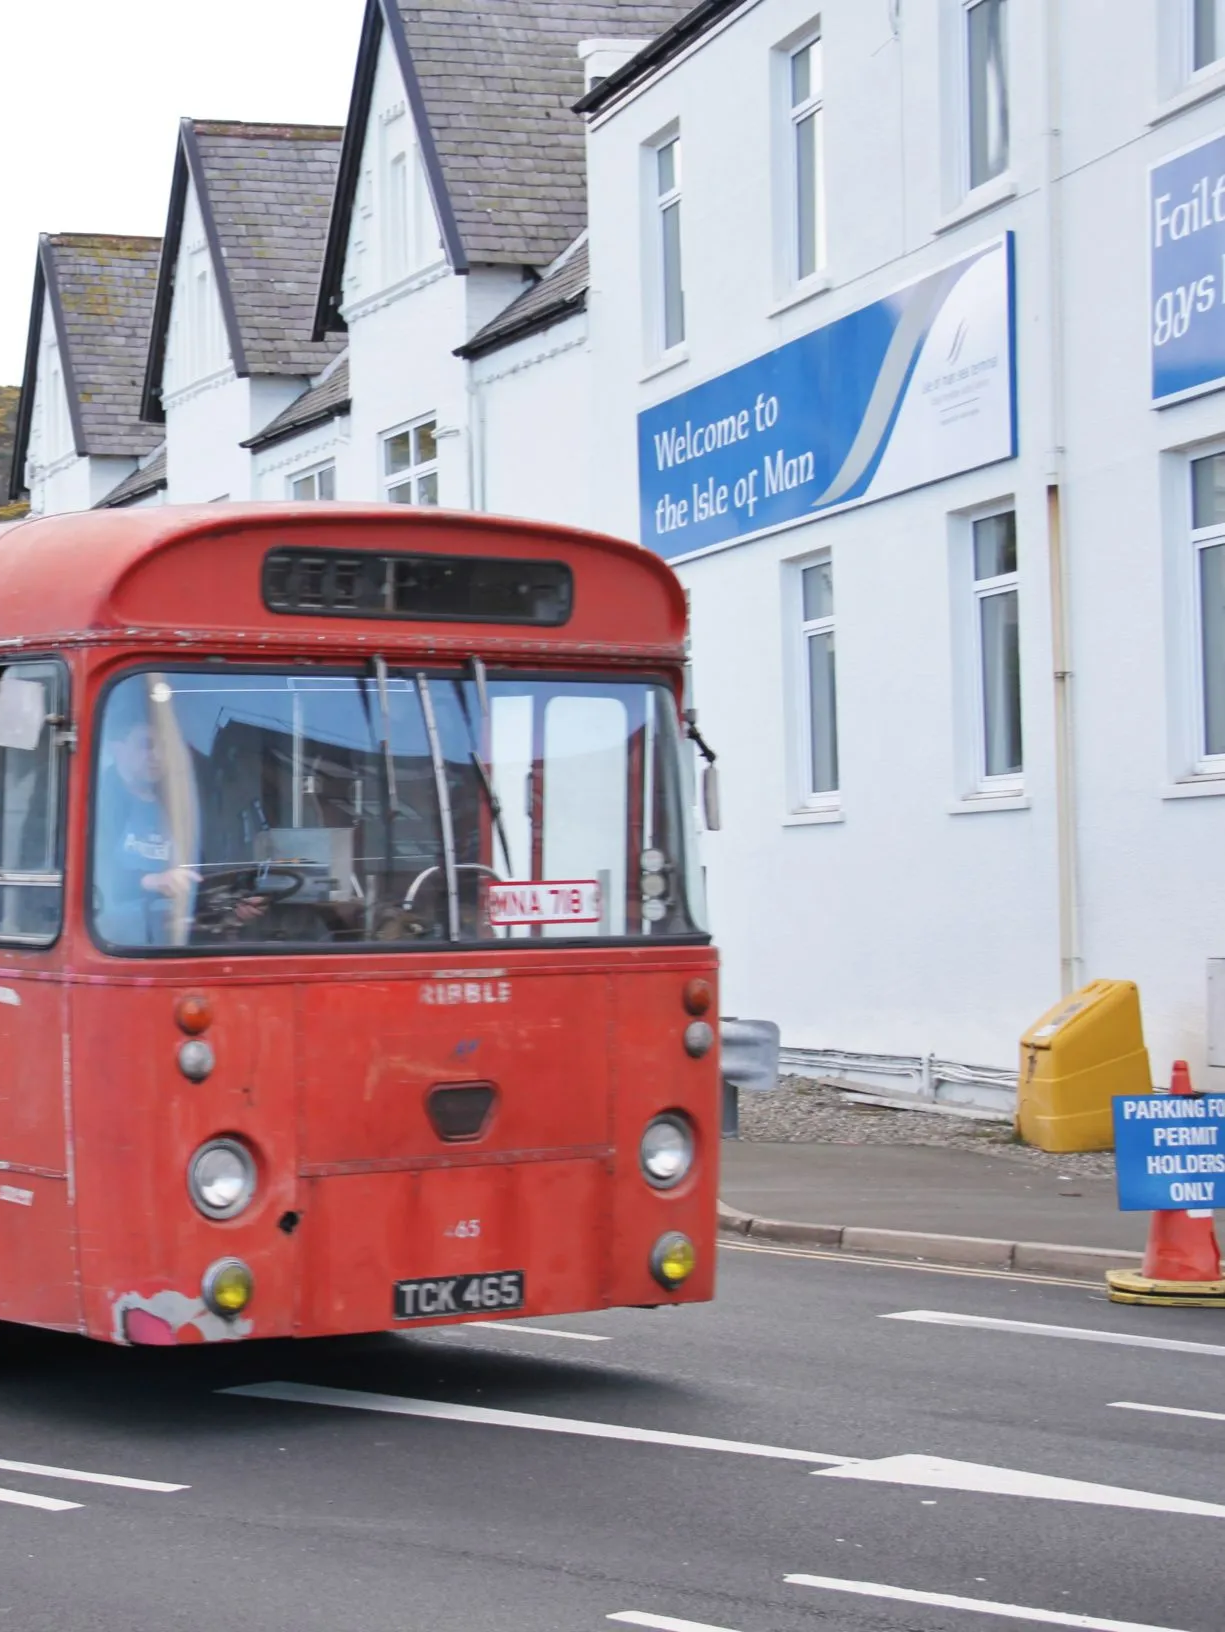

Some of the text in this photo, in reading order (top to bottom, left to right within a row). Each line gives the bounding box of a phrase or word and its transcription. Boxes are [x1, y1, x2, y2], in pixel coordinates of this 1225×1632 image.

[1153, 274, 1216, 347] gys
[654, 393, 778, 472] Welcome to
[656, 449, 815, 535] the Isle of Man
[419, 981, 513, 1006] RIBBLE
[1123, 1099, 1206, 1120] PARKING
[1153, 1127, 1219, 1147] PERMIT
[1146, 1153, 1225, 1175] HOLDERS
[1170, 1182, 1215, 1202] ONLY
[399, 1274, 520, 1315] TCK 465
